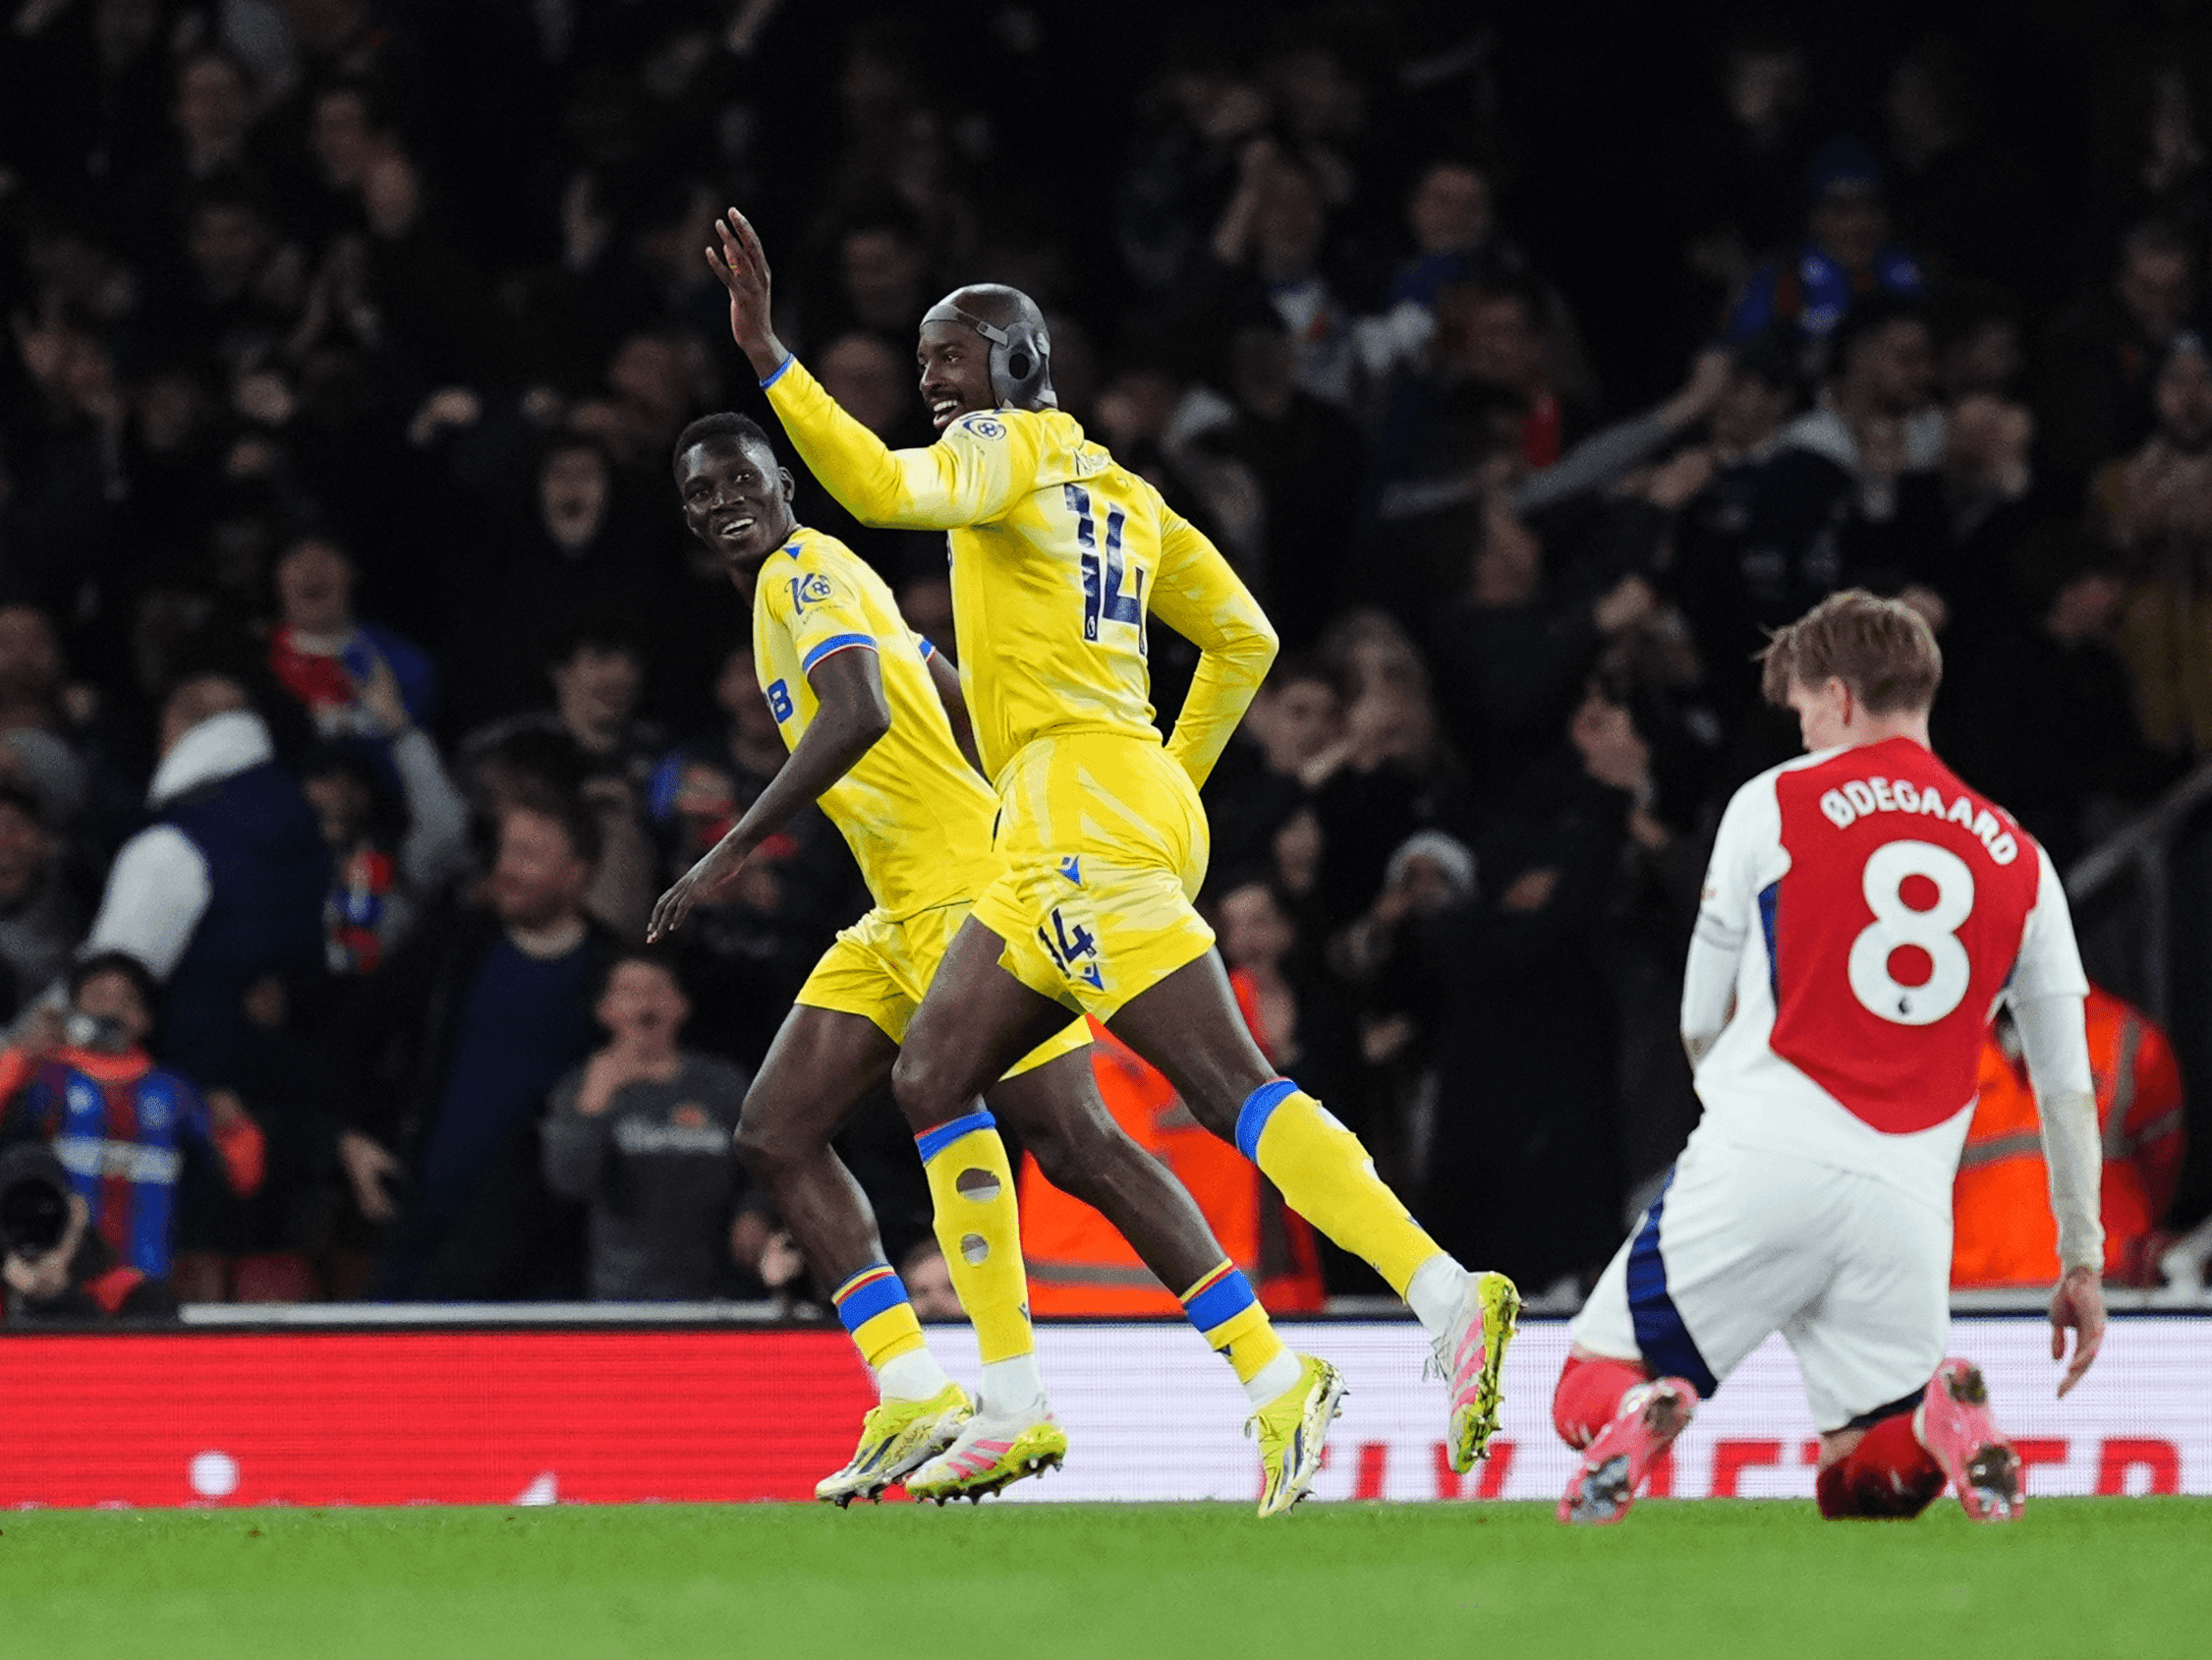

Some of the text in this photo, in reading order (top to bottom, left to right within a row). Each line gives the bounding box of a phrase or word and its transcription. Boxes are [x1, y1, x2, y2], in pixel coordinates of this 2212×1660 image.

[1064, 483, 1148, 656] 14
[1820, 776, 2017, 865] ØDEGAARD
[1038, 908, 1097, 980] 14
[1848, 839, 1975, 1026] 8
